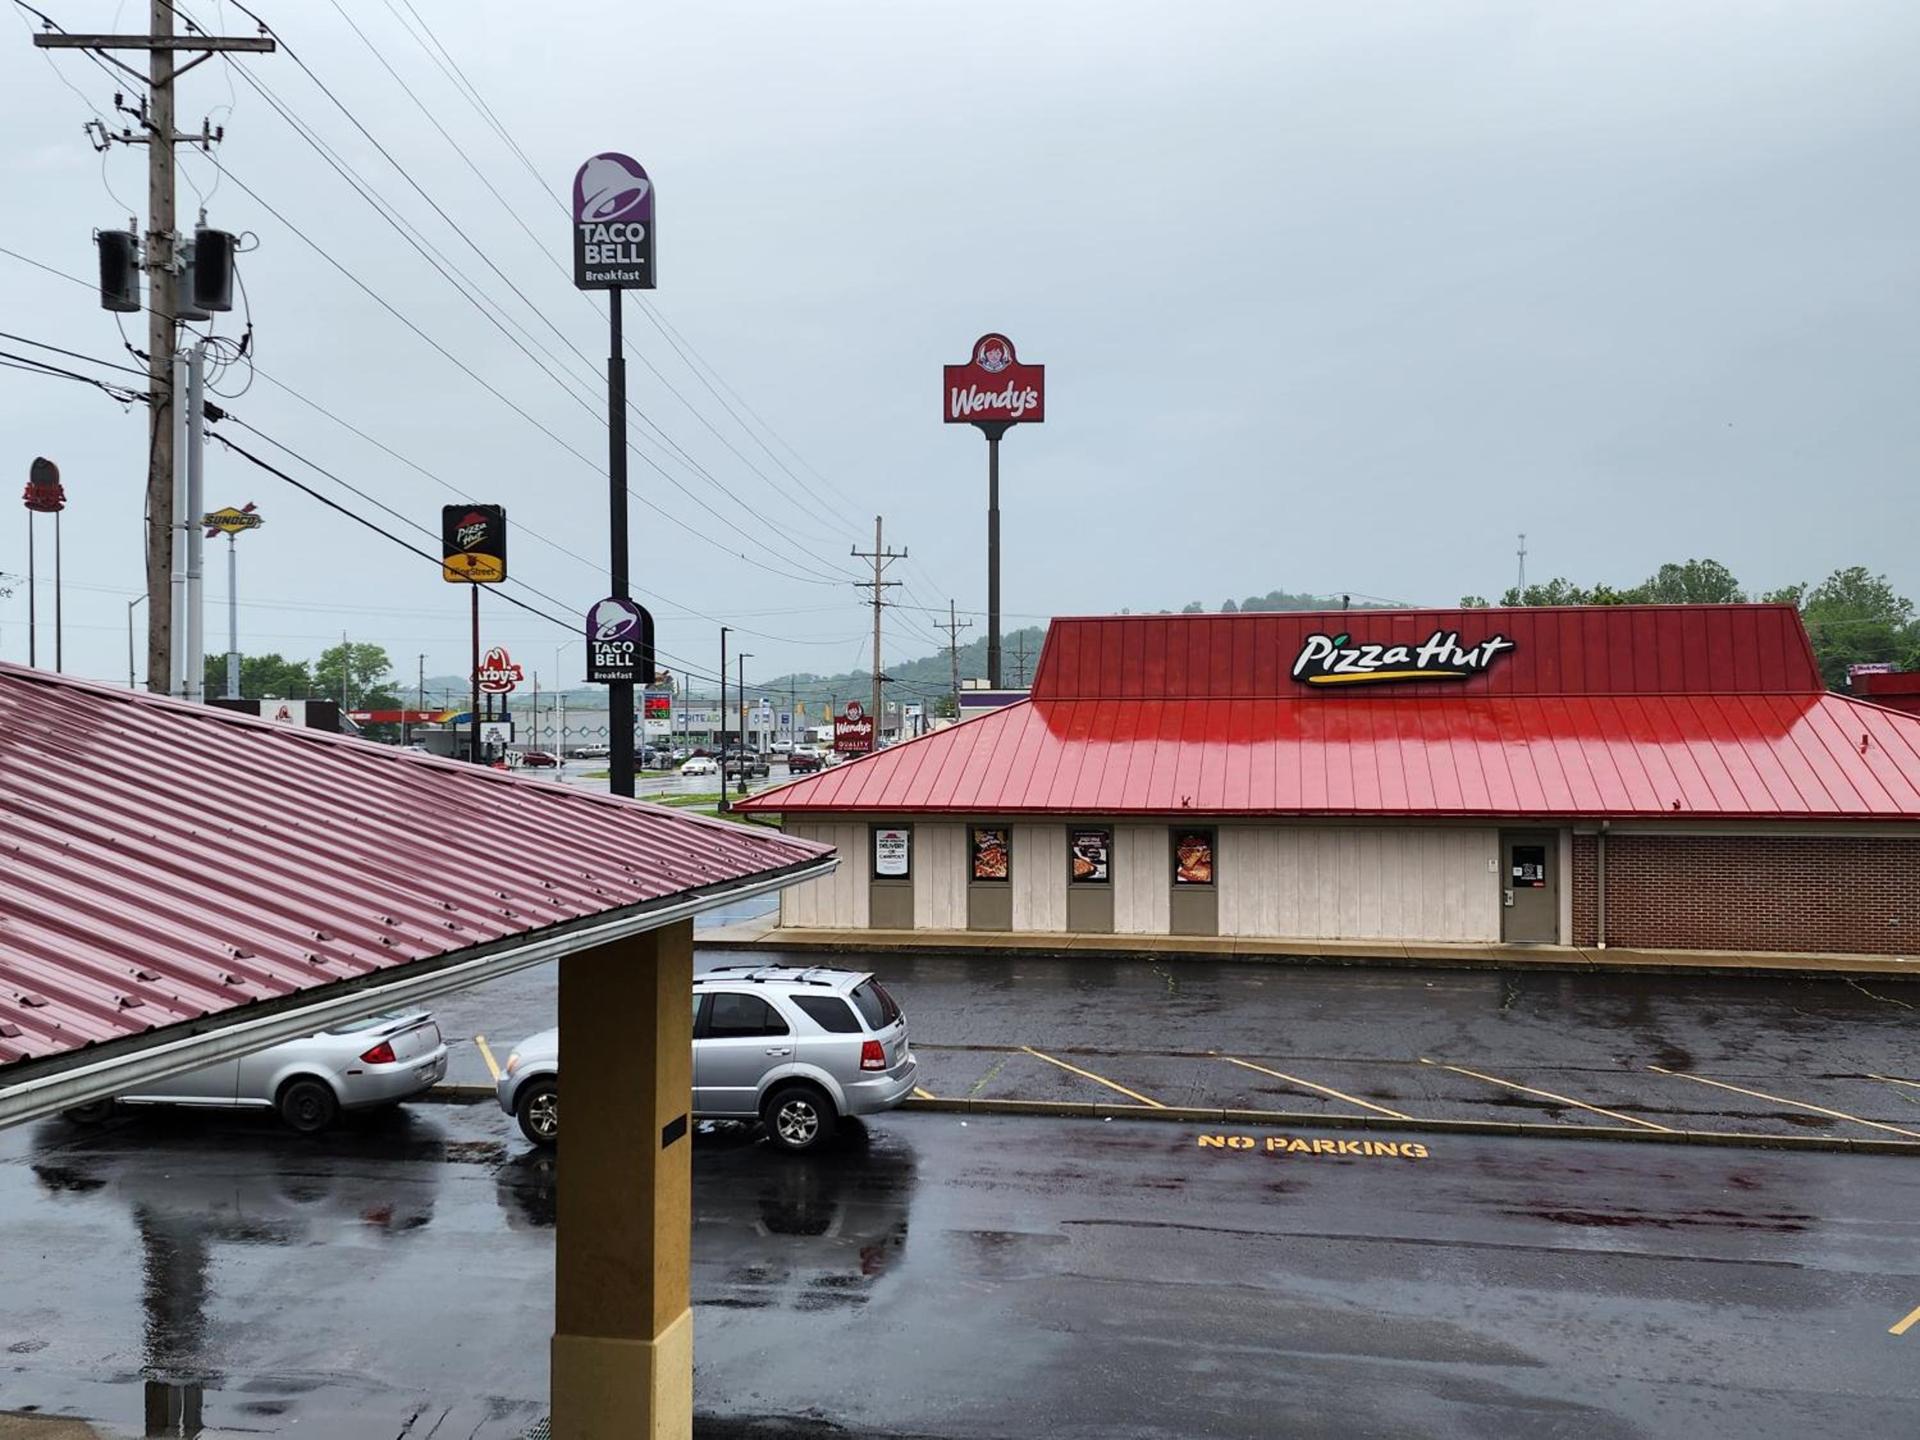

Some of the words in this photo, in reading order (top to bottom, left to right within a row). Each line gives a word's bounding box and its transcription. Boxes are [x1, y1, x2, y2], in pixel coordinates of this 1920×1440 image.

[579, 223, 646, 243] TACO
[585, 244, 645, 264] BELL
[585, 270, 640, 281] Breakfast
[951, 380, 1038, 418] Wendy's
[204, 515, 255, 526] SUNOCO
[456, 522, 488, 543] Pizza
[462, 531, 485, 546] Hut
[592, 641, 635, 654] TACO
[1293, 634, 1410, 676] Pizza
[1396, 632, 1513, 669] Hut
[595, 654, 634, 667] BELL
[594, 671, 633, 680] Breakfast
[836, 721, 872, 736] Wendy's
[1198, 1134, 1256, 1149] NO
[1266, 1137, 1430, 1159] PARKING
